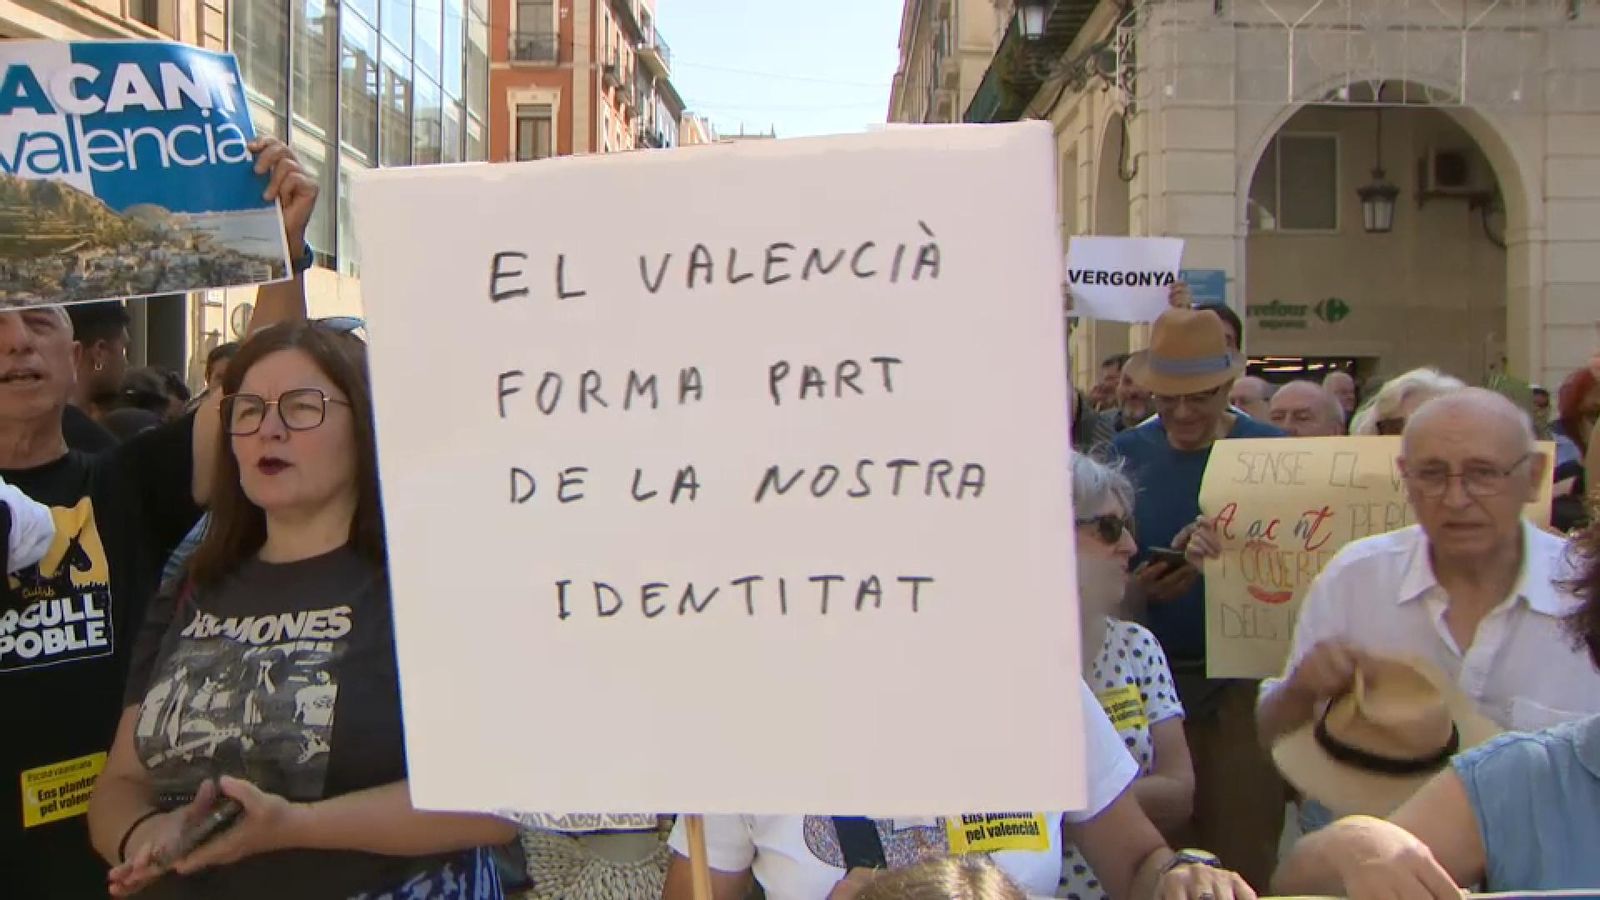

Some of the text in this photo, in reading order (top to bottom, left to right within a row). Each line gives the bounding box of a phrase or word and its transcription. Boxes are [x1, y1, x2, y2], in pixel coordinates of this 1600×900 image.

[488, 220, 942, 303] EL VALENCIÀ
[1068, 269, 1176, 287] VERGONYA
[497, 356, 903, 418] FORMA PART
[510, 458, 987, 504] DE LA NOSTRA
[1231, 451, 1315, 487] SENSE
[554, 574, 935, 620] IDENTITAT
[0, 620, 108, 660] POBLE
[40, 800, 58, 817] pel
[965, 825, 986, 844] pel
